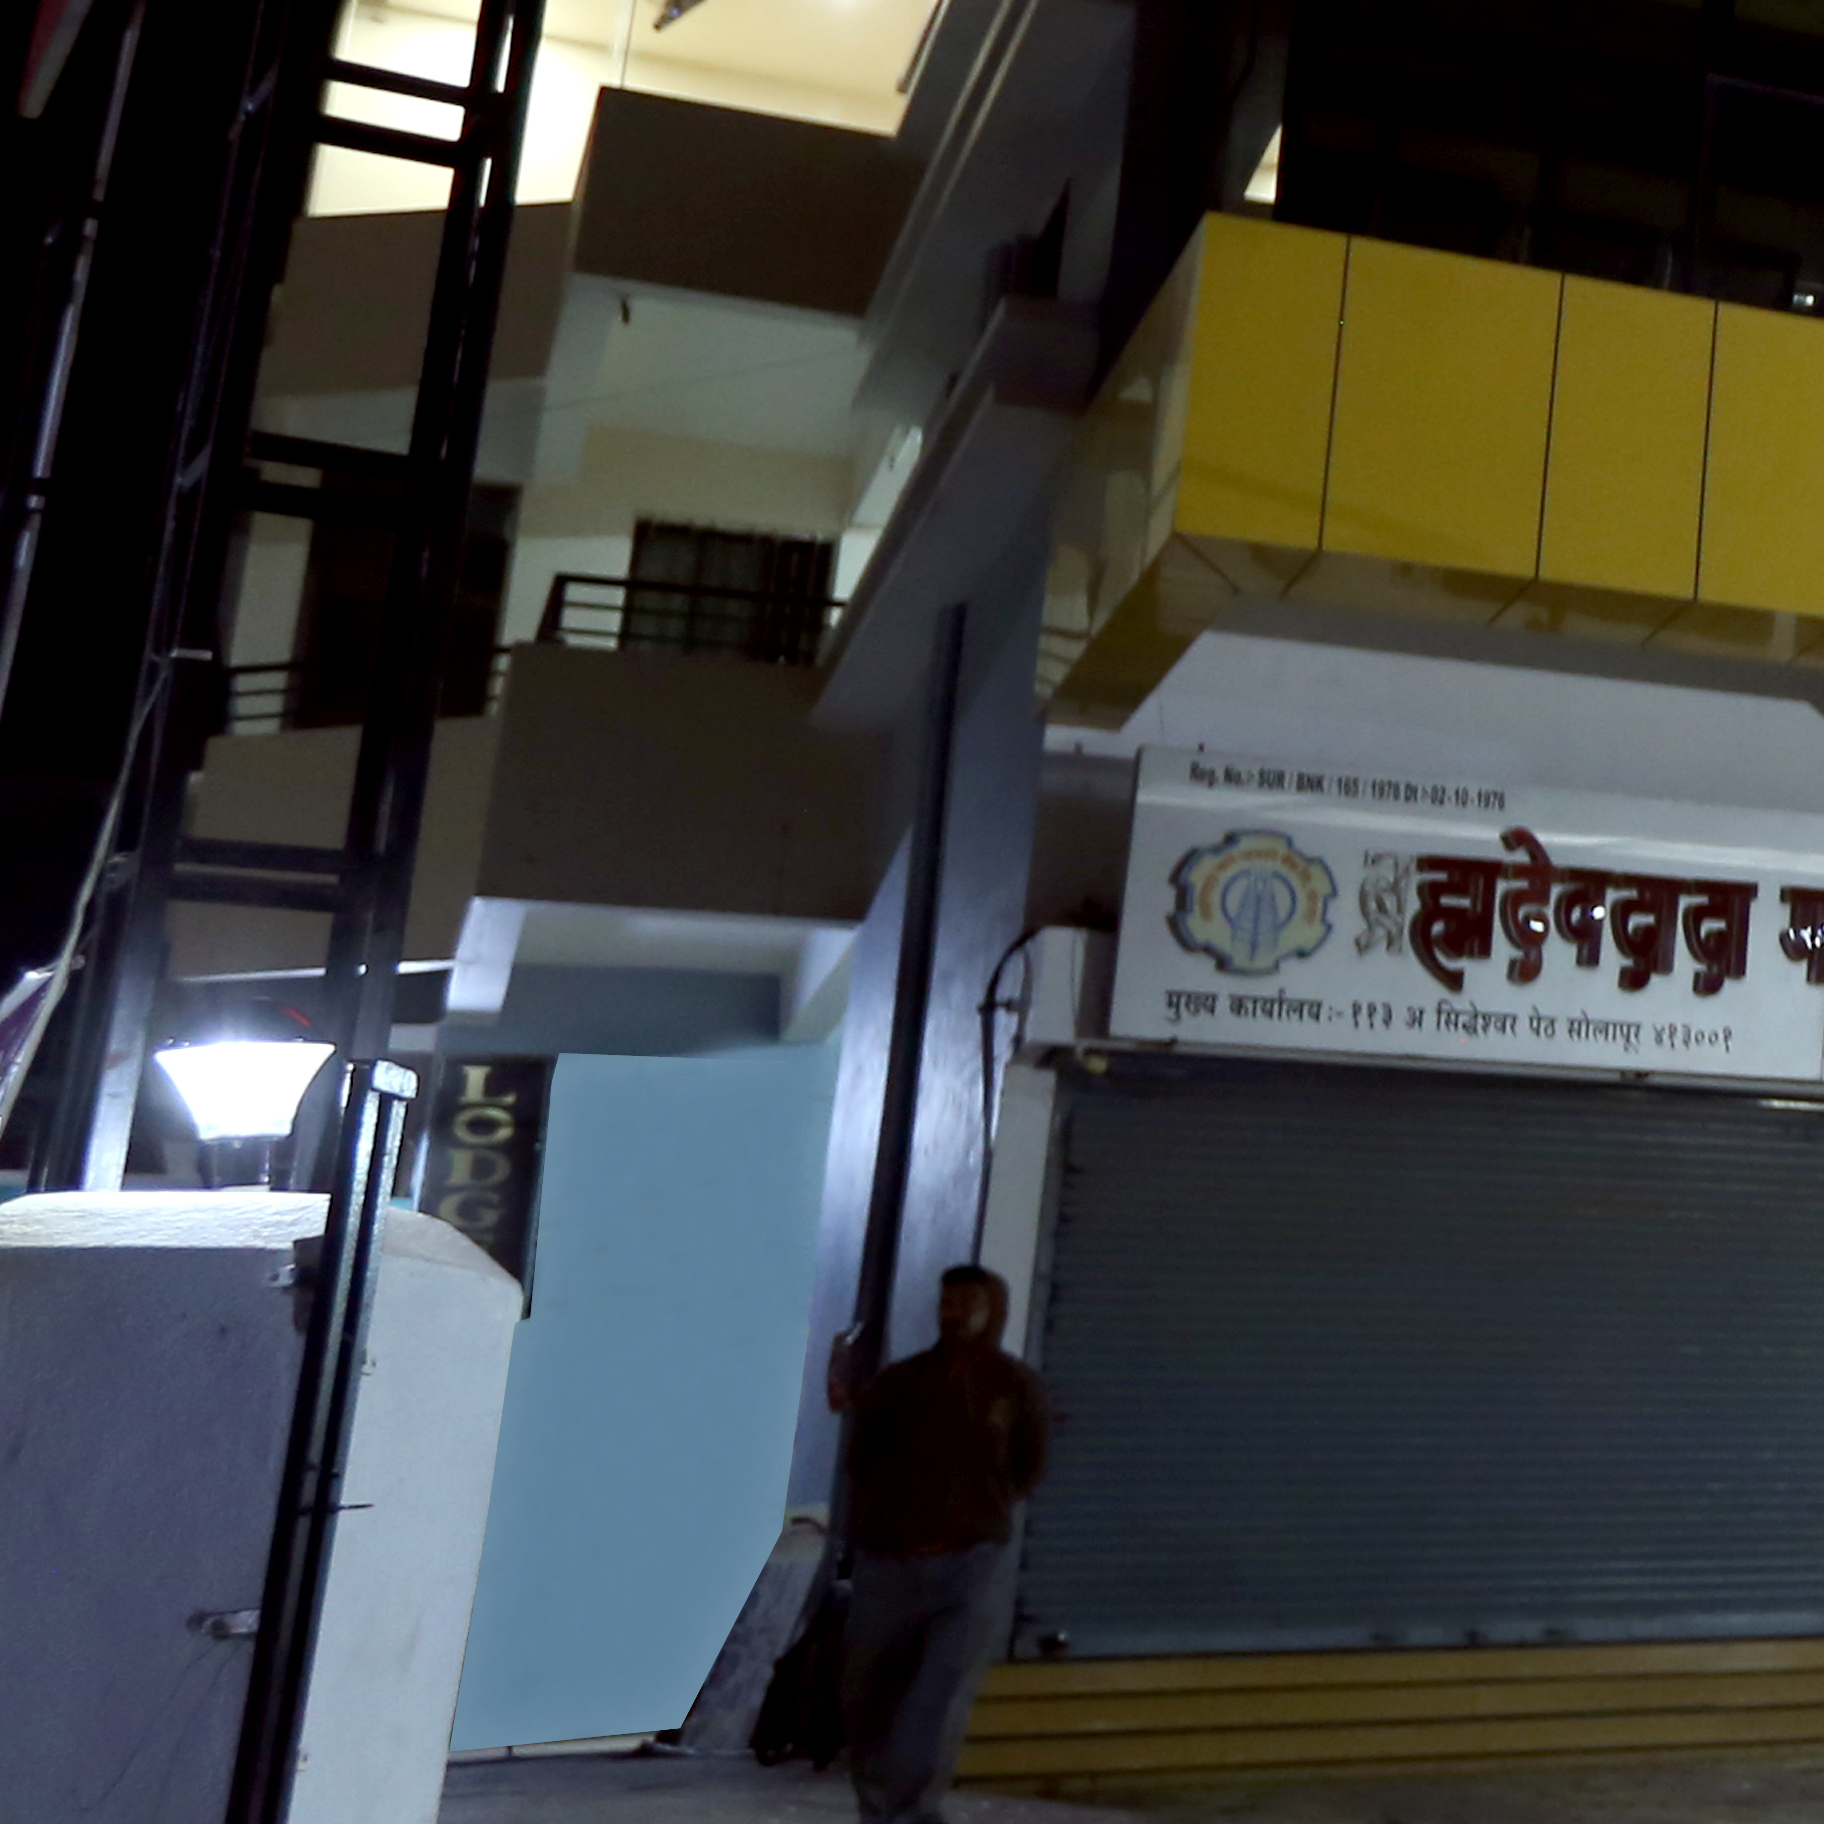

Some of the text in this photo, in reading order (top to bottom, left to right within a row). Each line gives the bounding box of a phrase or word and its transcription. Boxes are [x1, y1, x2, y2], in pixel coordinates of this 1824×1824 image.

[1164, 989, 1219, 1025] मुख्य
[1404, 1005, 1426, 1032] अ
[1527, 1004, 1557, 1039] पेठ
[1566, 1009, 1643, 1055] सोलापूर
